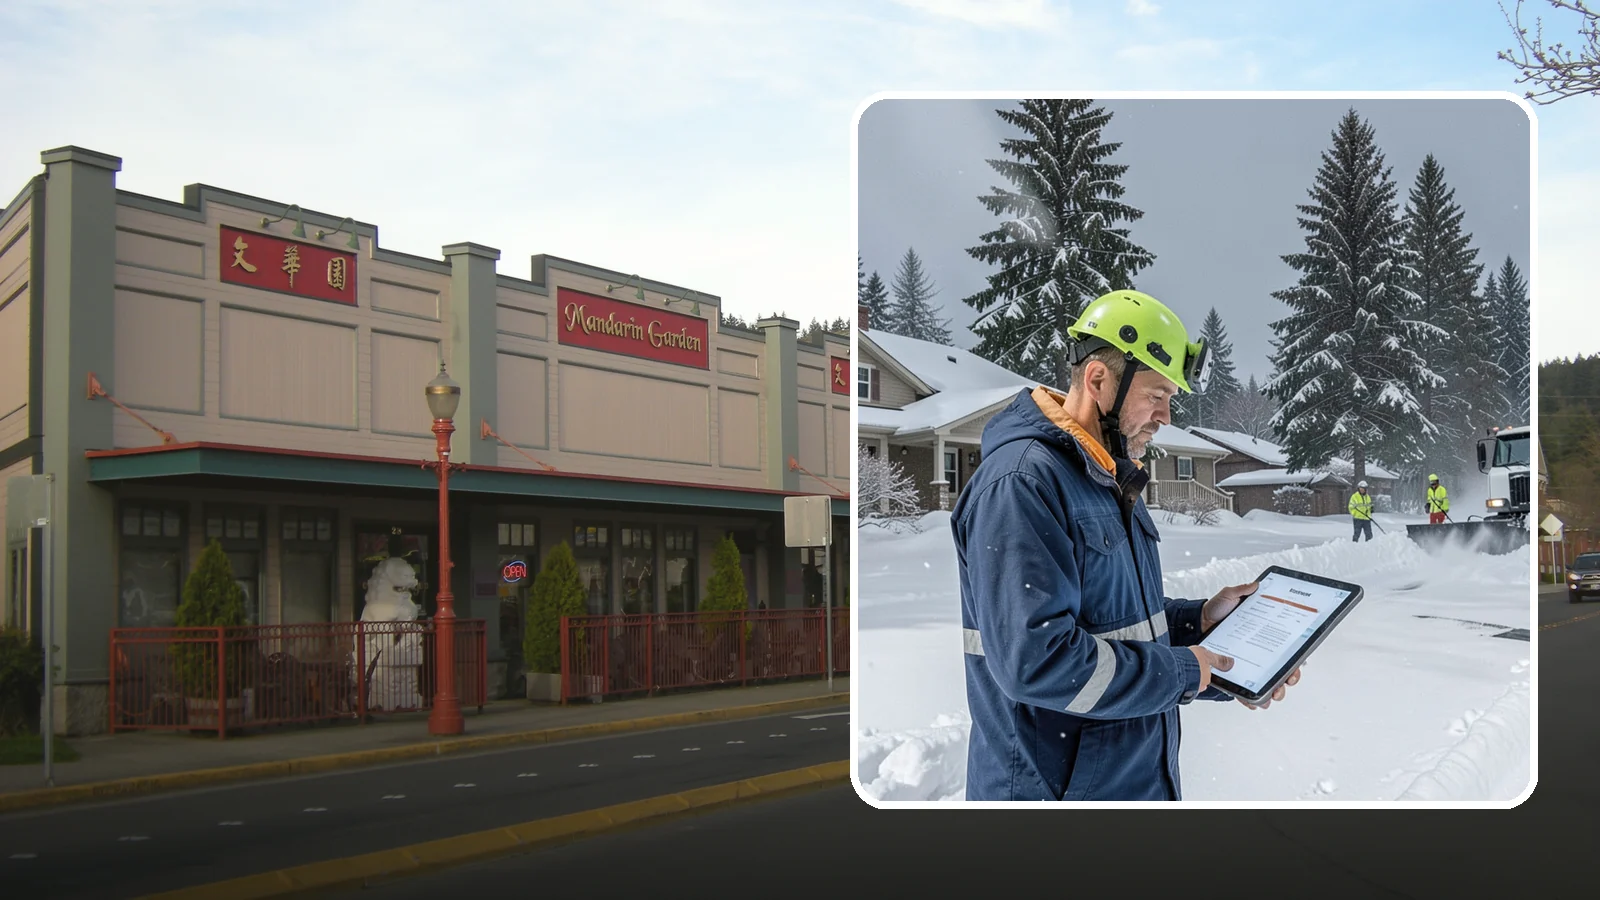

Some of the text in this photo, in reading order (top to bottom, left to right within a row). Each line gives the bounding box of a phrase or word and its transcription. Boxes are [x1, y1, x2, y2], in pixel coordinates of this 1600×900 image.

[565, 302, 701, 352] Mandarin Garden
[503, 565, 527, 578] OPEN
